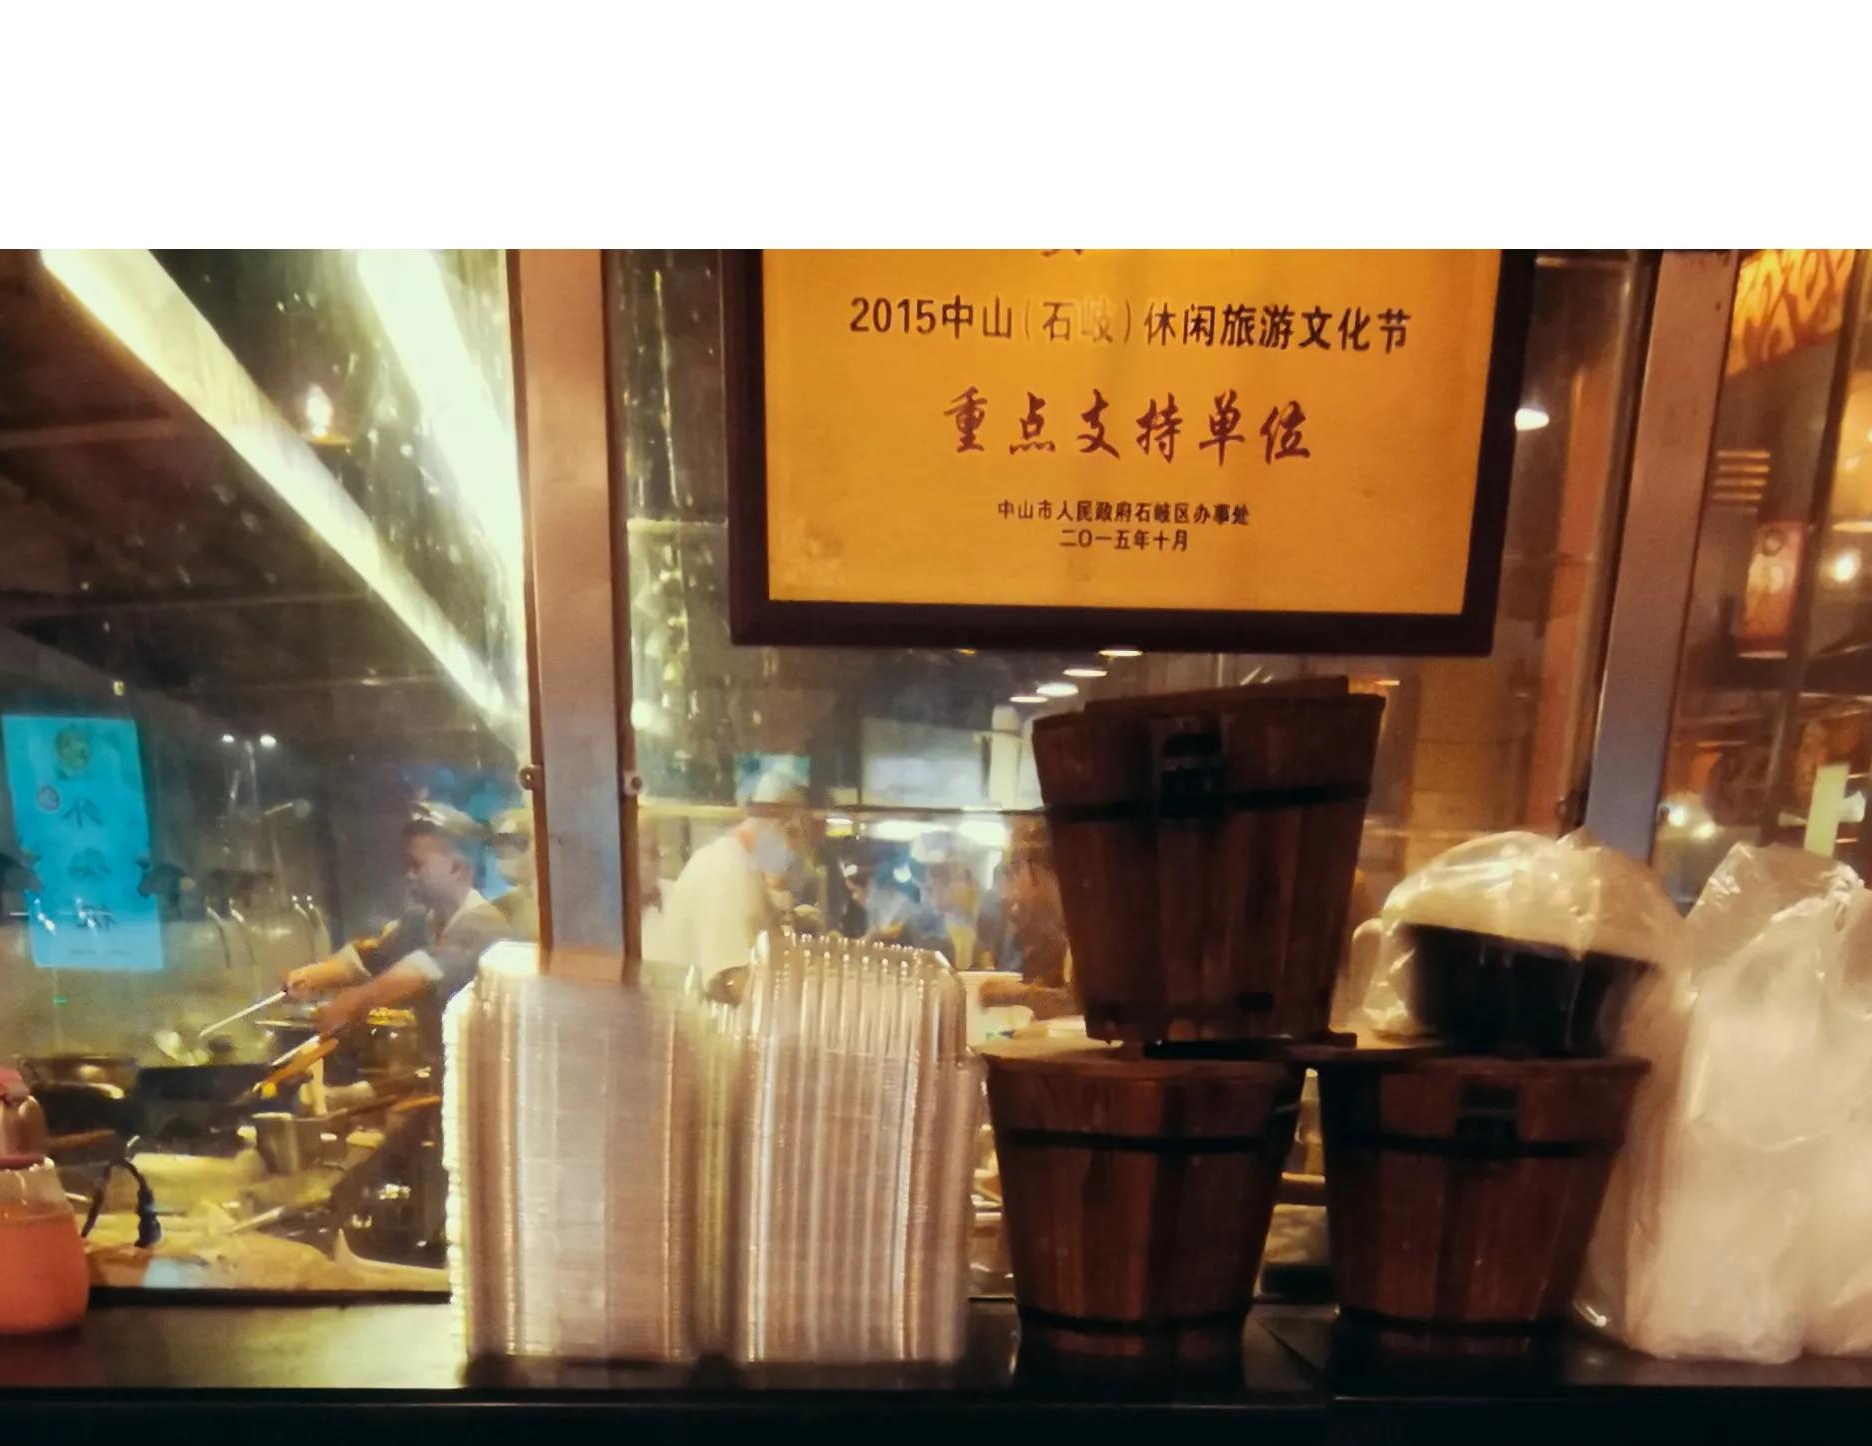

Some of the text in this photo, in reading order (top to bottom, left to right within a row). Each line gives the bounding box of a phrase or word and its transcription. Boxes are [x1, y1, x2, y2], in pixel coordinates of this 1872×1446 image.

[943, 386, 1311, 464] 重点支持单位
[997, 499, 1250, 526] 中山市人民政府石岐区办事处
